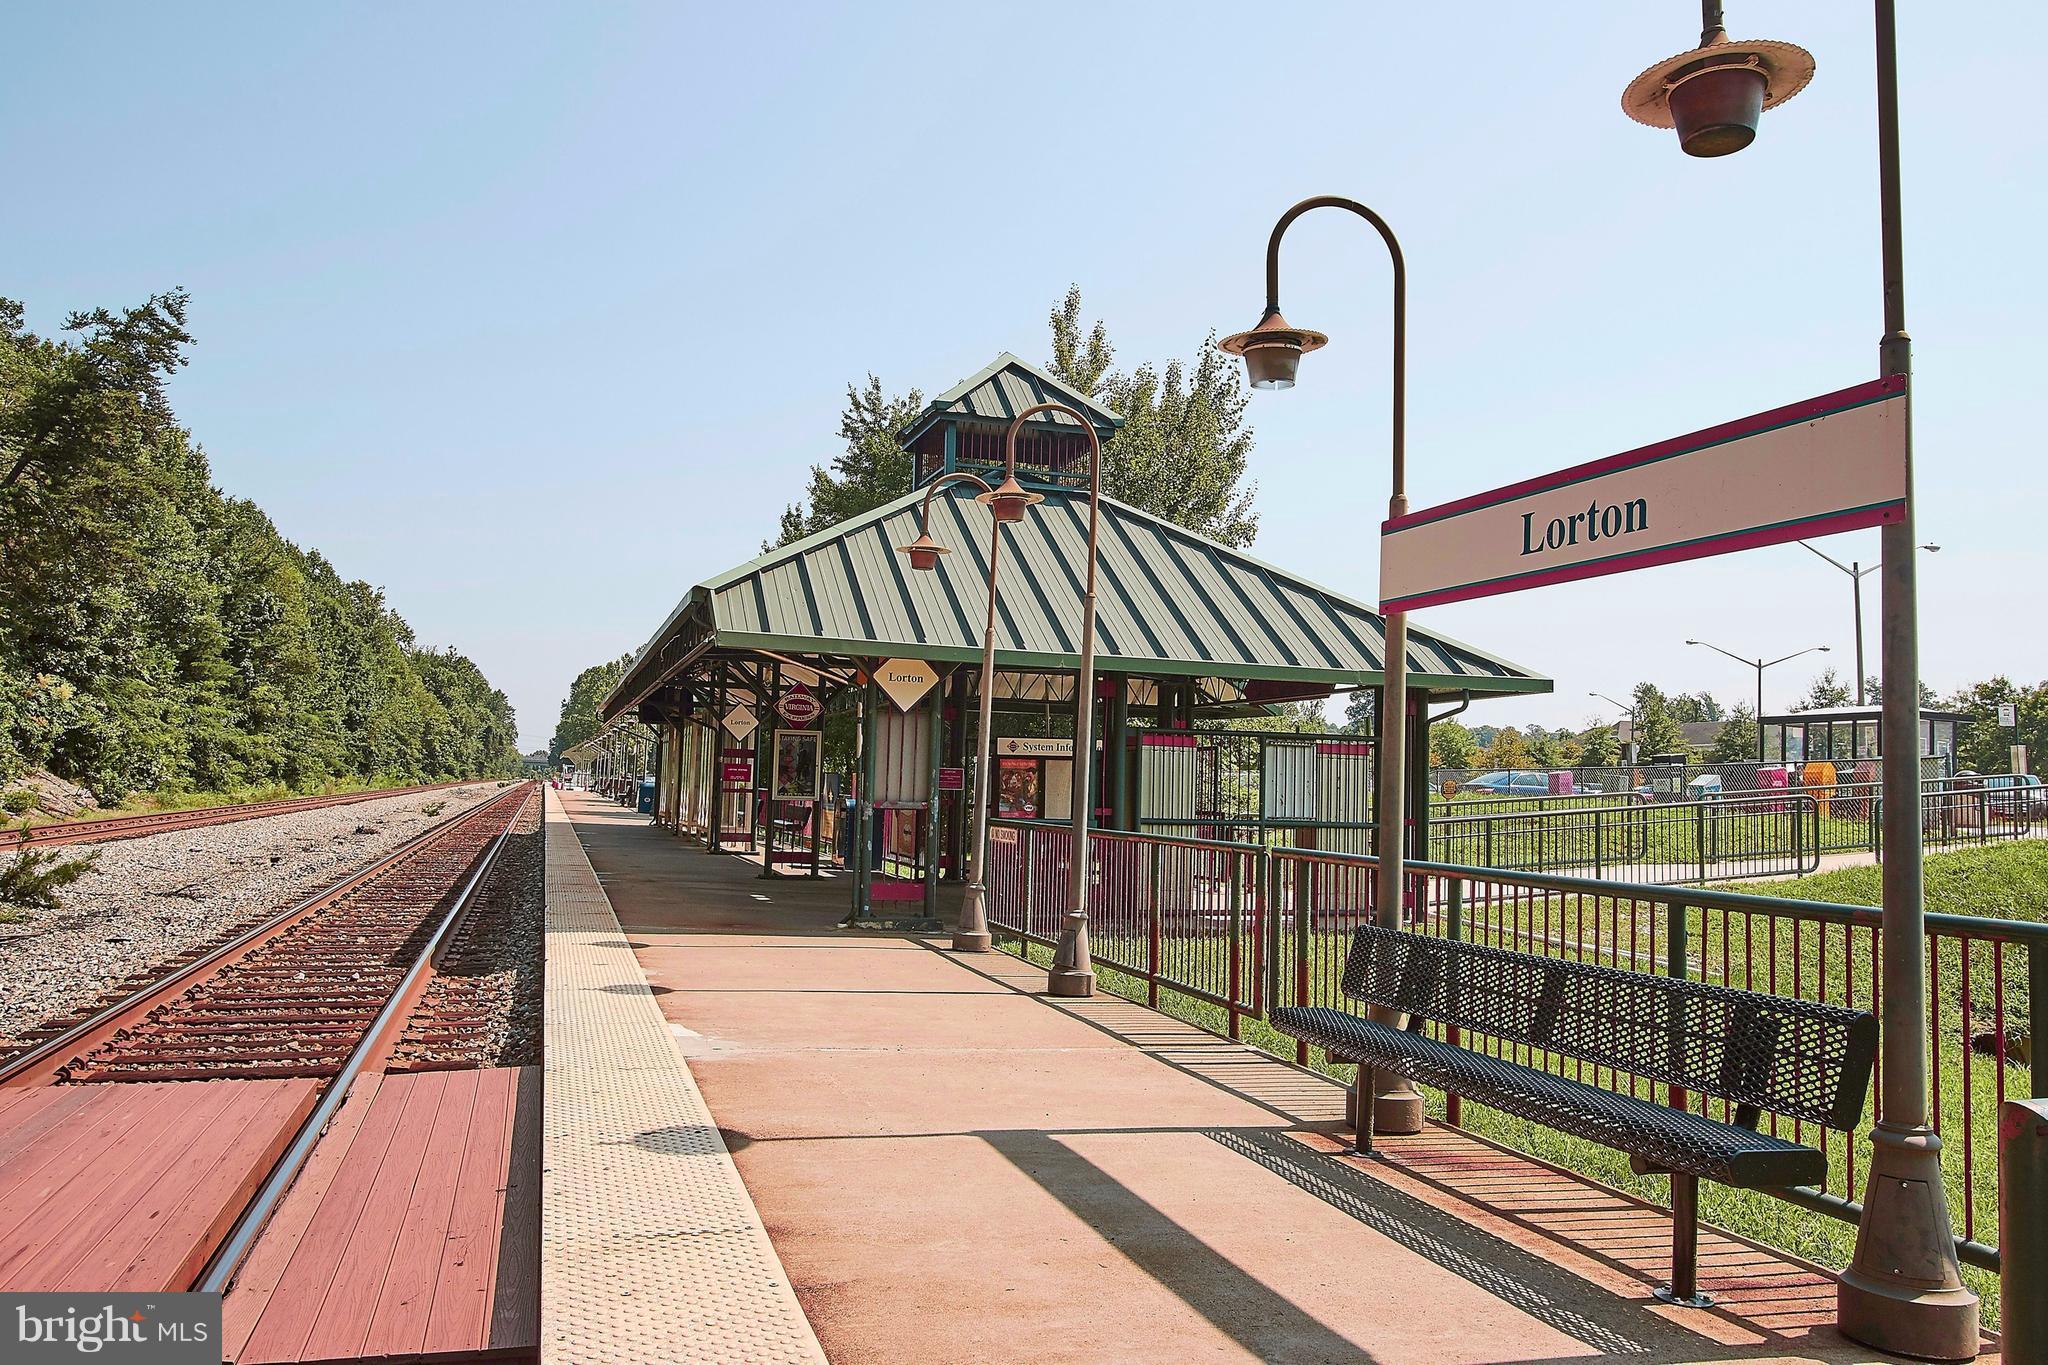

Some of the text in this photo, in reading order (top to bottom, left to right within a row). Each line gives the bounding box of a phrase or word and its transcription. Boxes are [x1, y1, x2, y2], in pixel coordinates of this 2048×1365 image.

[1519, 496, 1649, 557] Lorton
[888, 672, 924, 683] Lorton
[784, 703, 814, 711] VIRGINIA
[1022, 742, 1054, 753] System
